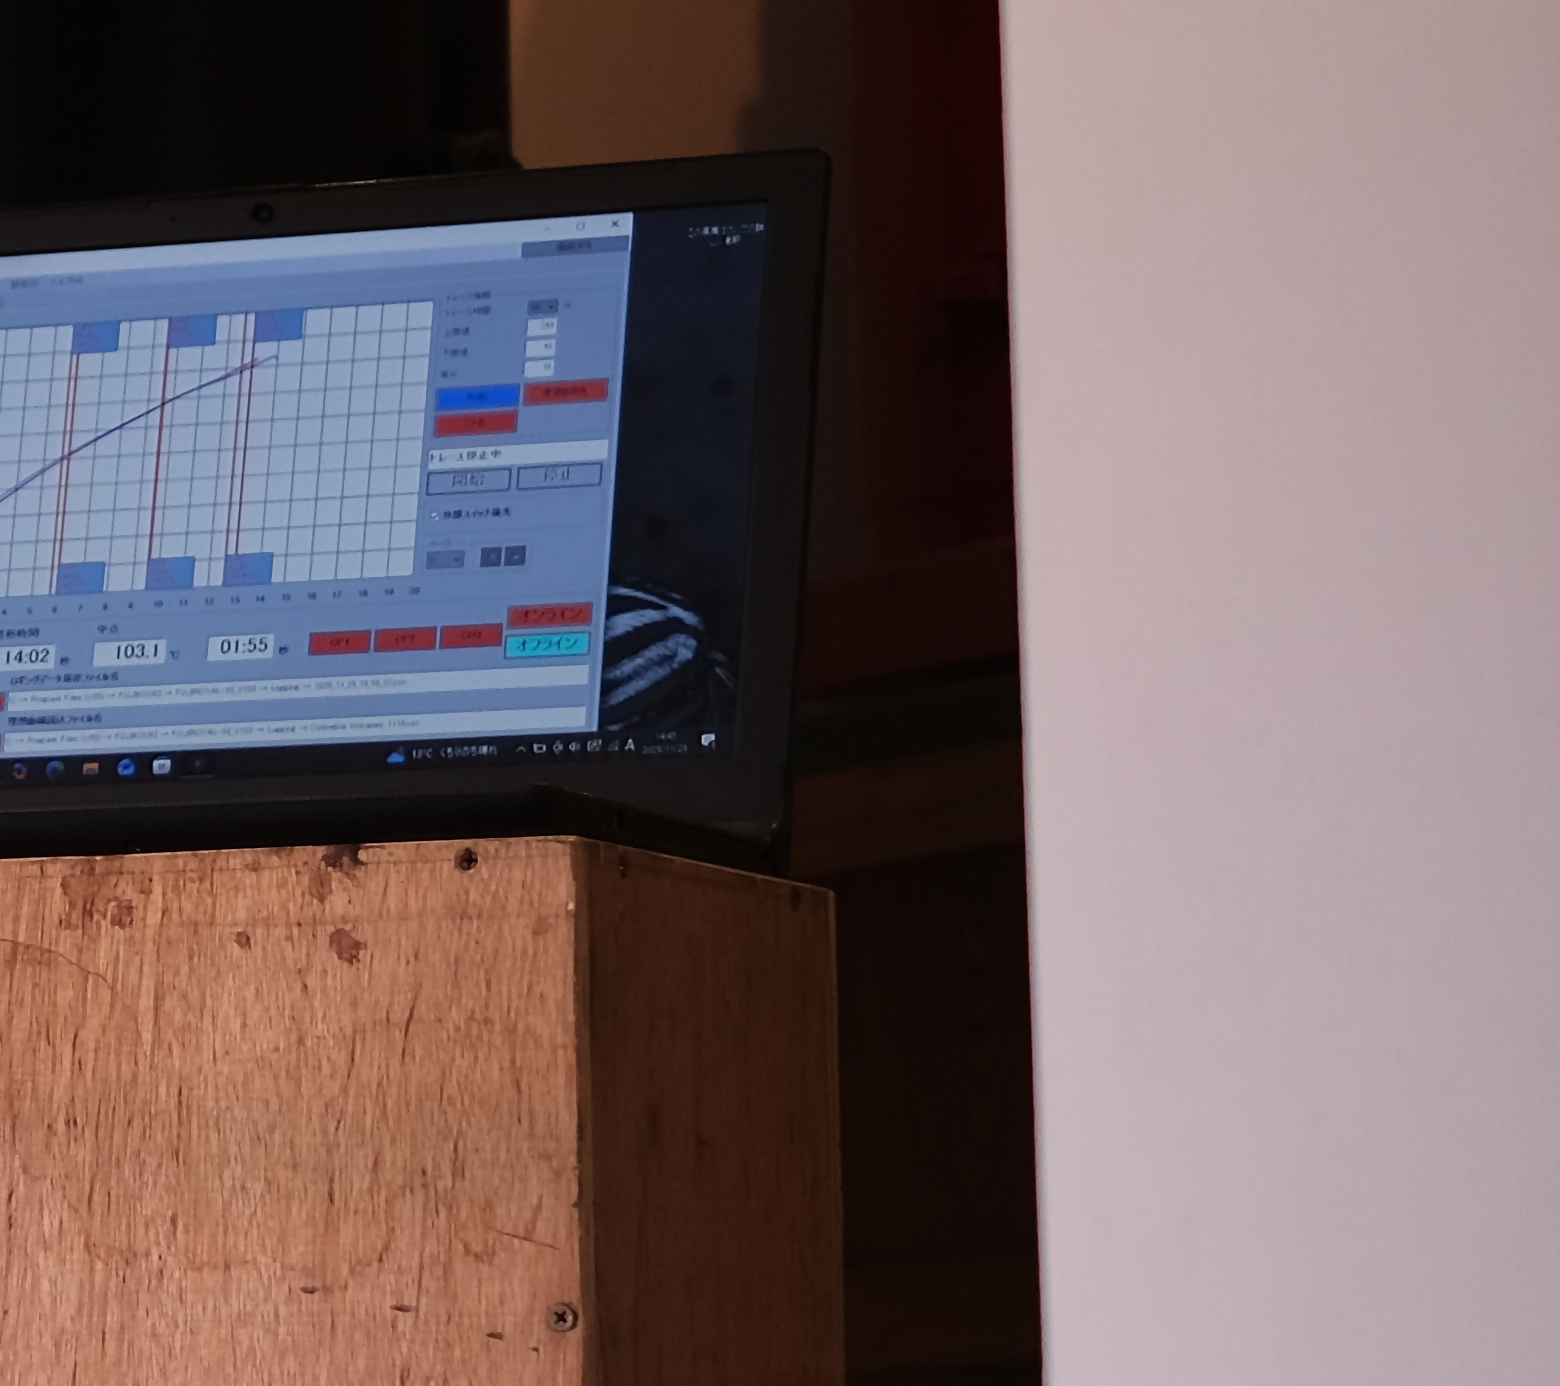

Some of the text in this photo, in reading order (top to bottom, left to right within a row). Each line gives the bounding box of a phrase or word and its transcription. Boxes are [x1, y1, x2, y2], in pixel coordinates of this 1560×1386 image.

[543, 466, 571, 483] 停止
[523, 607, 583, 623] オンライン
[116, 643, 160, 660] 103.1
[220, 636, 269, 655] 01:55
[516, 636, 578, 652] オフライン
[5, 647, 51, 665] 14:02
[624, 737, 636, 753] A
